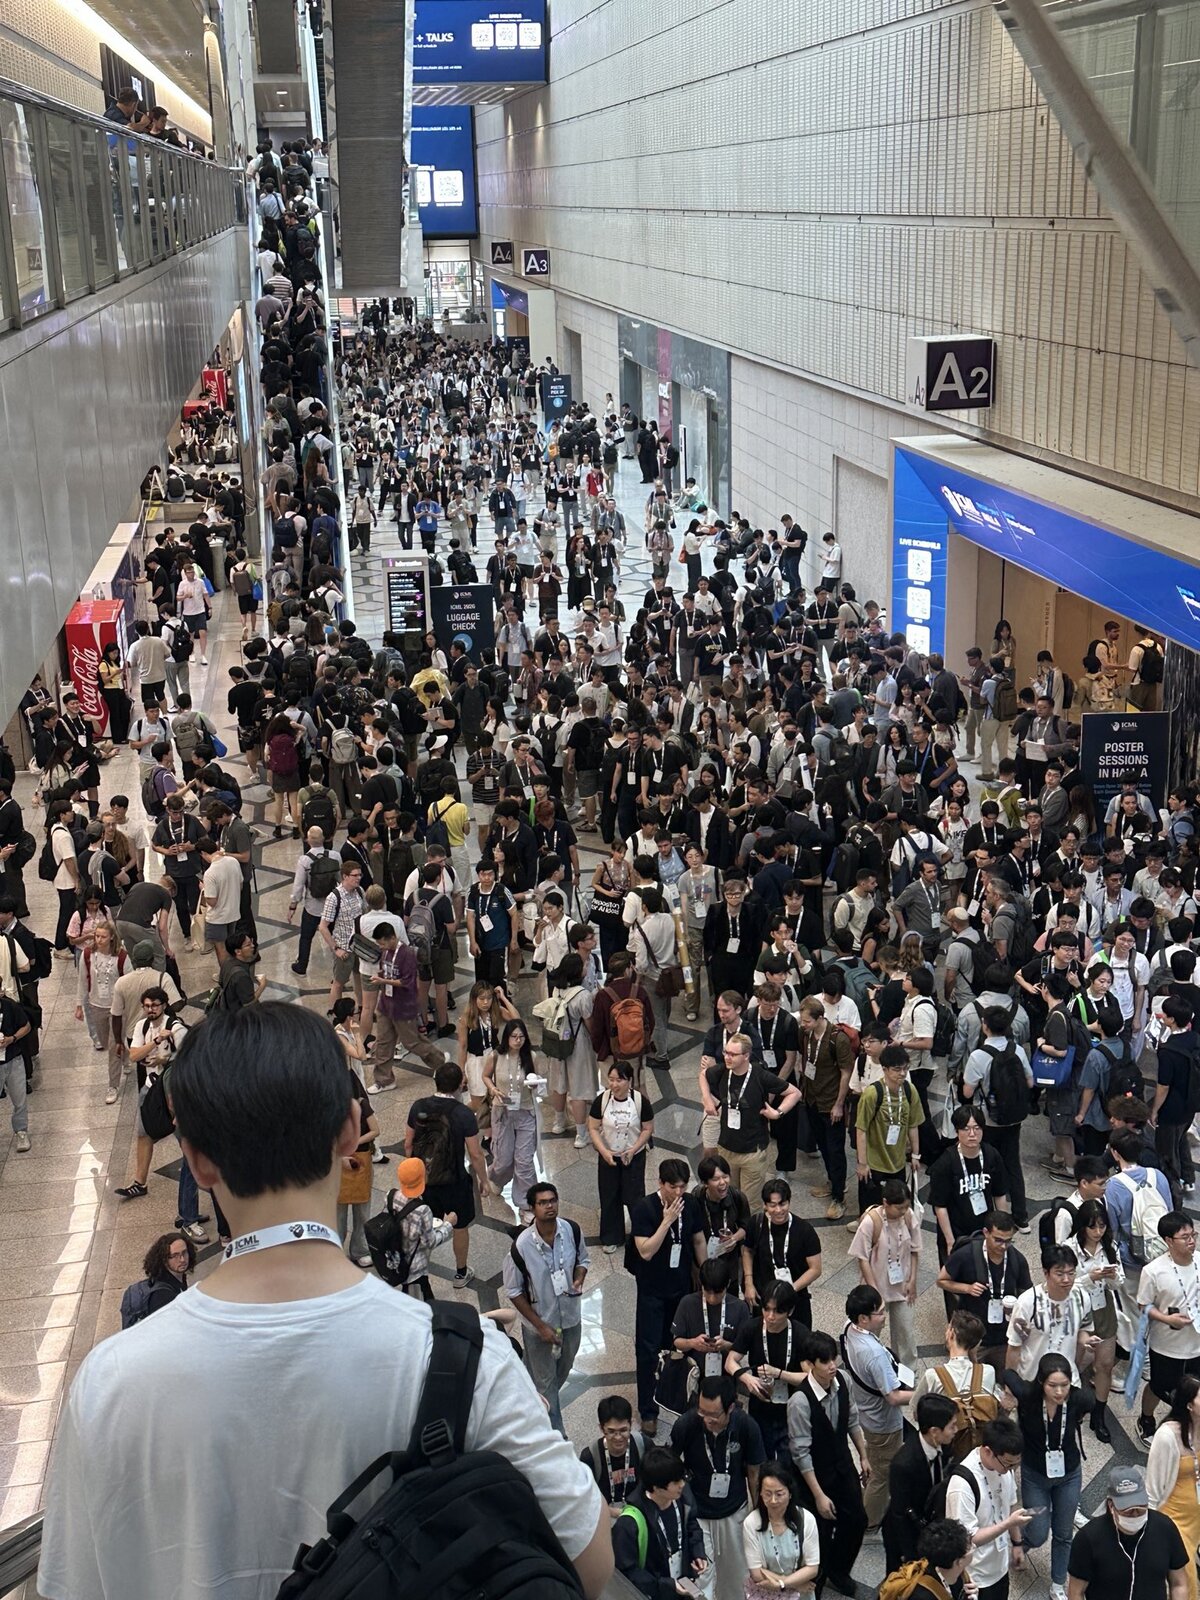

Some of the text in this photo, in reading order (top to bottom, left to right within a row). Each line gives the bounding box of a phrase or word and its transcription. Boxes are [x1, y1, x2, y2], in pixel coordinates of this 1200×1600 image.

[425, 32, 454, 43] TALKS
[493, 245, 512, 262] A4
[526, 253, 548, 273] A3
[929, 352, 989, 401] A2
[446, 612, 481, 622] LUGGAGE
[451, 622, 477, 631] CHECK
[1104, 742, 1144, 752] POSTER
[1098, 754, 1149, 766] SESSIONS
[1098, 768, 1109, 778] IN
[1140, 767, 1148, 778] A
[959, 1173, 991, 1195] HUF
[306, 1224, 329, 1235] ICML
[234, 1234, 260, 1249] ICML
